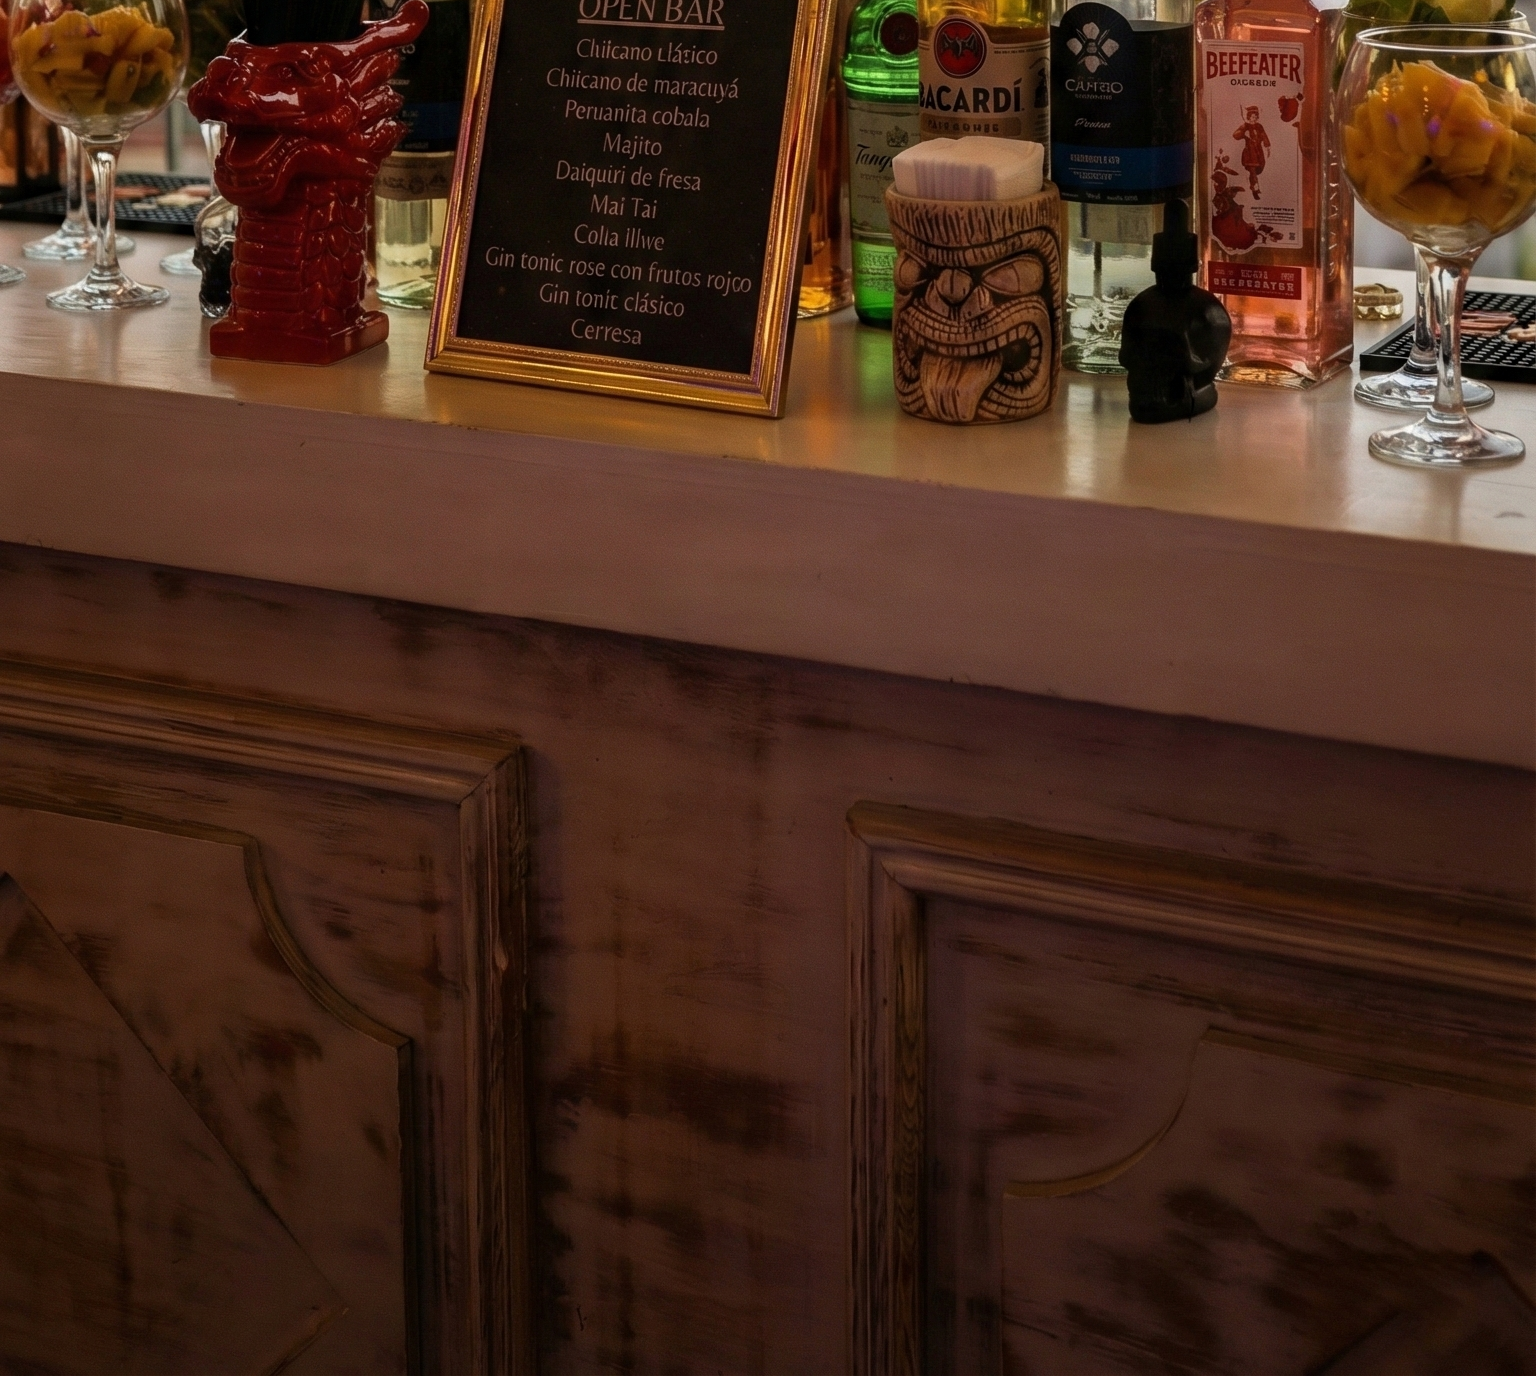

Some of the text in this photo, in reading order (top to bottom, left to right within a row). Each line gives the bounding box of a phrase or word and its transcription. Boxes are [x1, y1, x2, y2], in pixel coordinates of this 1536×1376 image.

[1206, 51, 1302, 84] BEEFEATER
[626, 73, 648, 92] de
[654, 78, 739, 104] maracuyá
[565, 99, 710, 128] Peruanita cobala
[603, 132, 662, 159] Majito
[556, 160, 701, 190] Daiquiri de fresa
[590, 194, 657, 218] Mai Tai
[485, 246, 515, 267] Gin
[521, 252, 564, 273] tonic
[569, 259, 605, 277] rose
[611, 263, 642, 281] con
[648, 261, 701, 287] frutos
[539, 283, 569, 306] Gin
[624, 291, 685, 317] clásico
[571, 318, 642, 345] Cerresa
